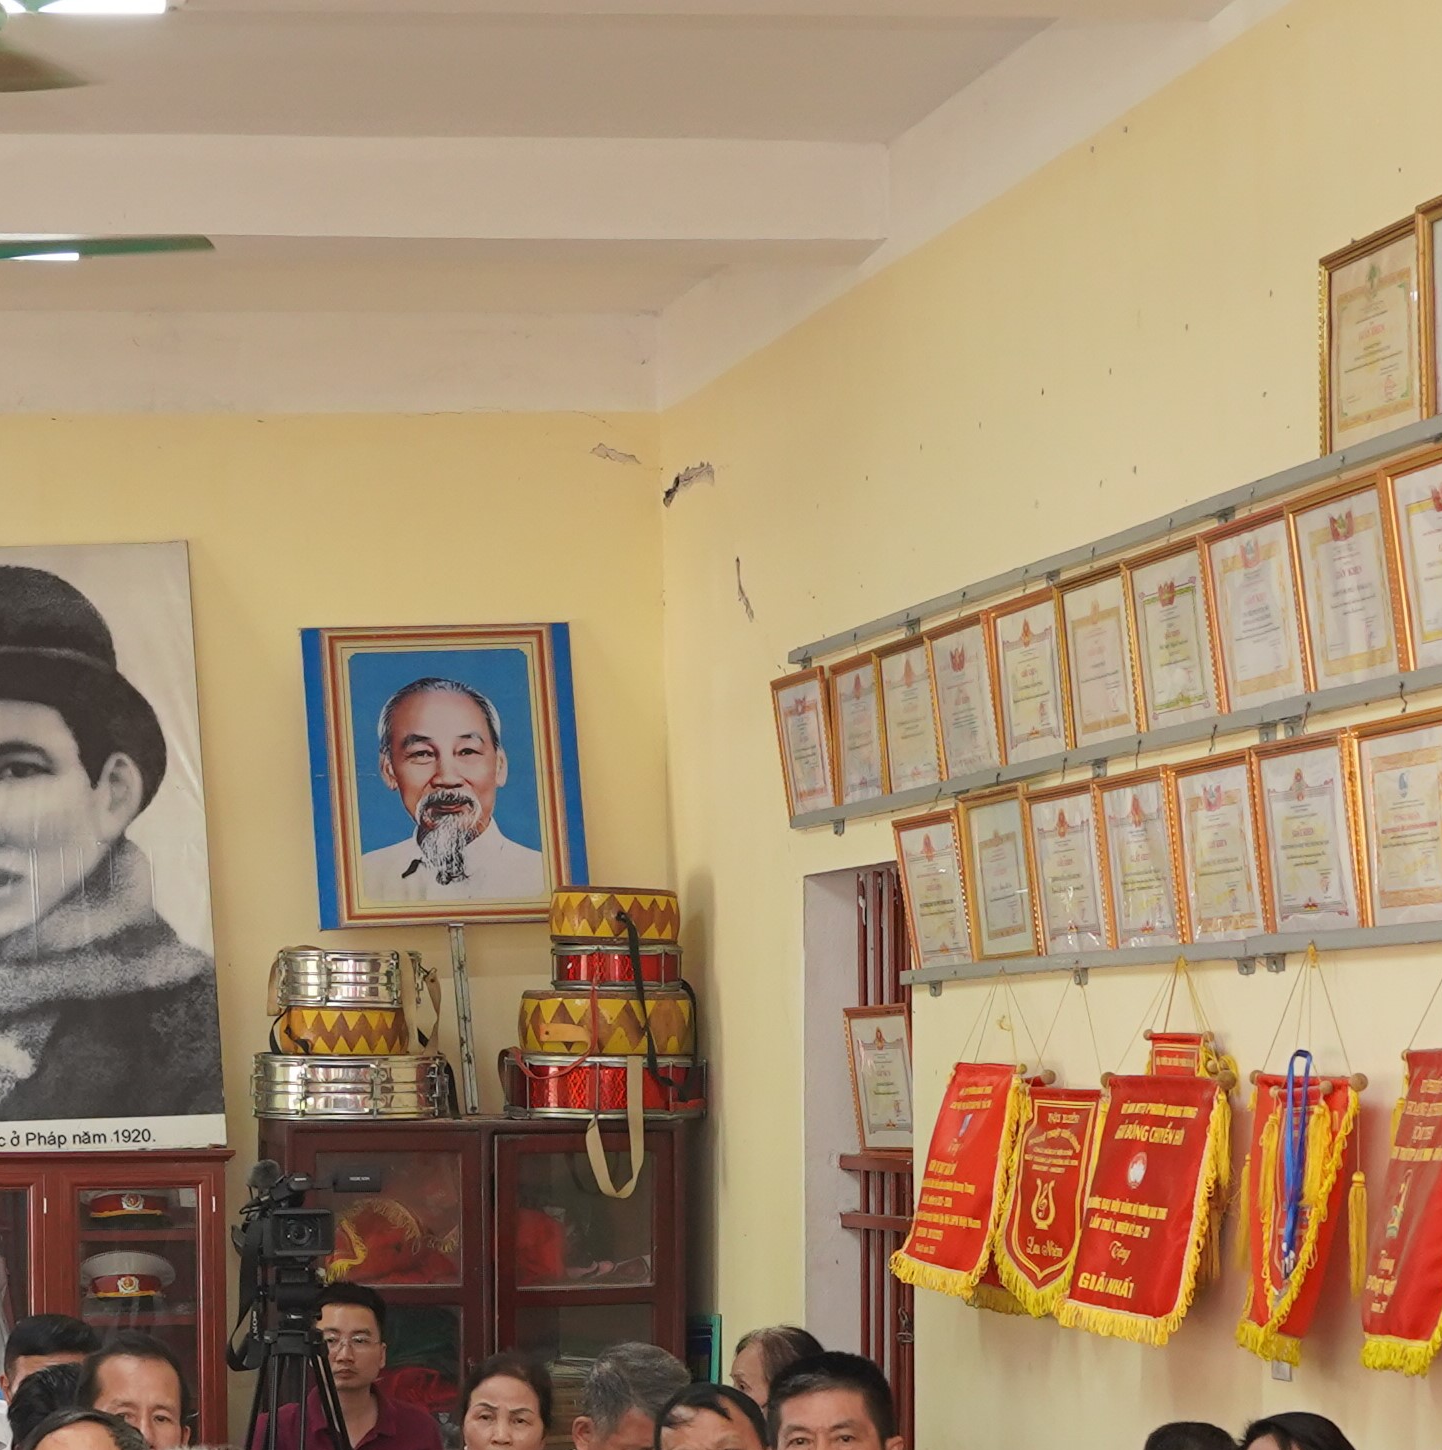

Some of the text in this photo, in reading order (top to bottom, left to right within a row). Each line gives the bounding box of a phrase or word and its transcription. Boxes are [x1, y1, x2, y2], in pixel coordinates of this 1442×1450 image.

[10, 1130, 20, 1147] ở
[26, 1131, 67, 1150] Pháp
[72, 1130, 107, 1146] năm
[113, 1128, 157, 1145] 1920.
[1077, 1271, 1135, 1299] GIẢI NHẤT
